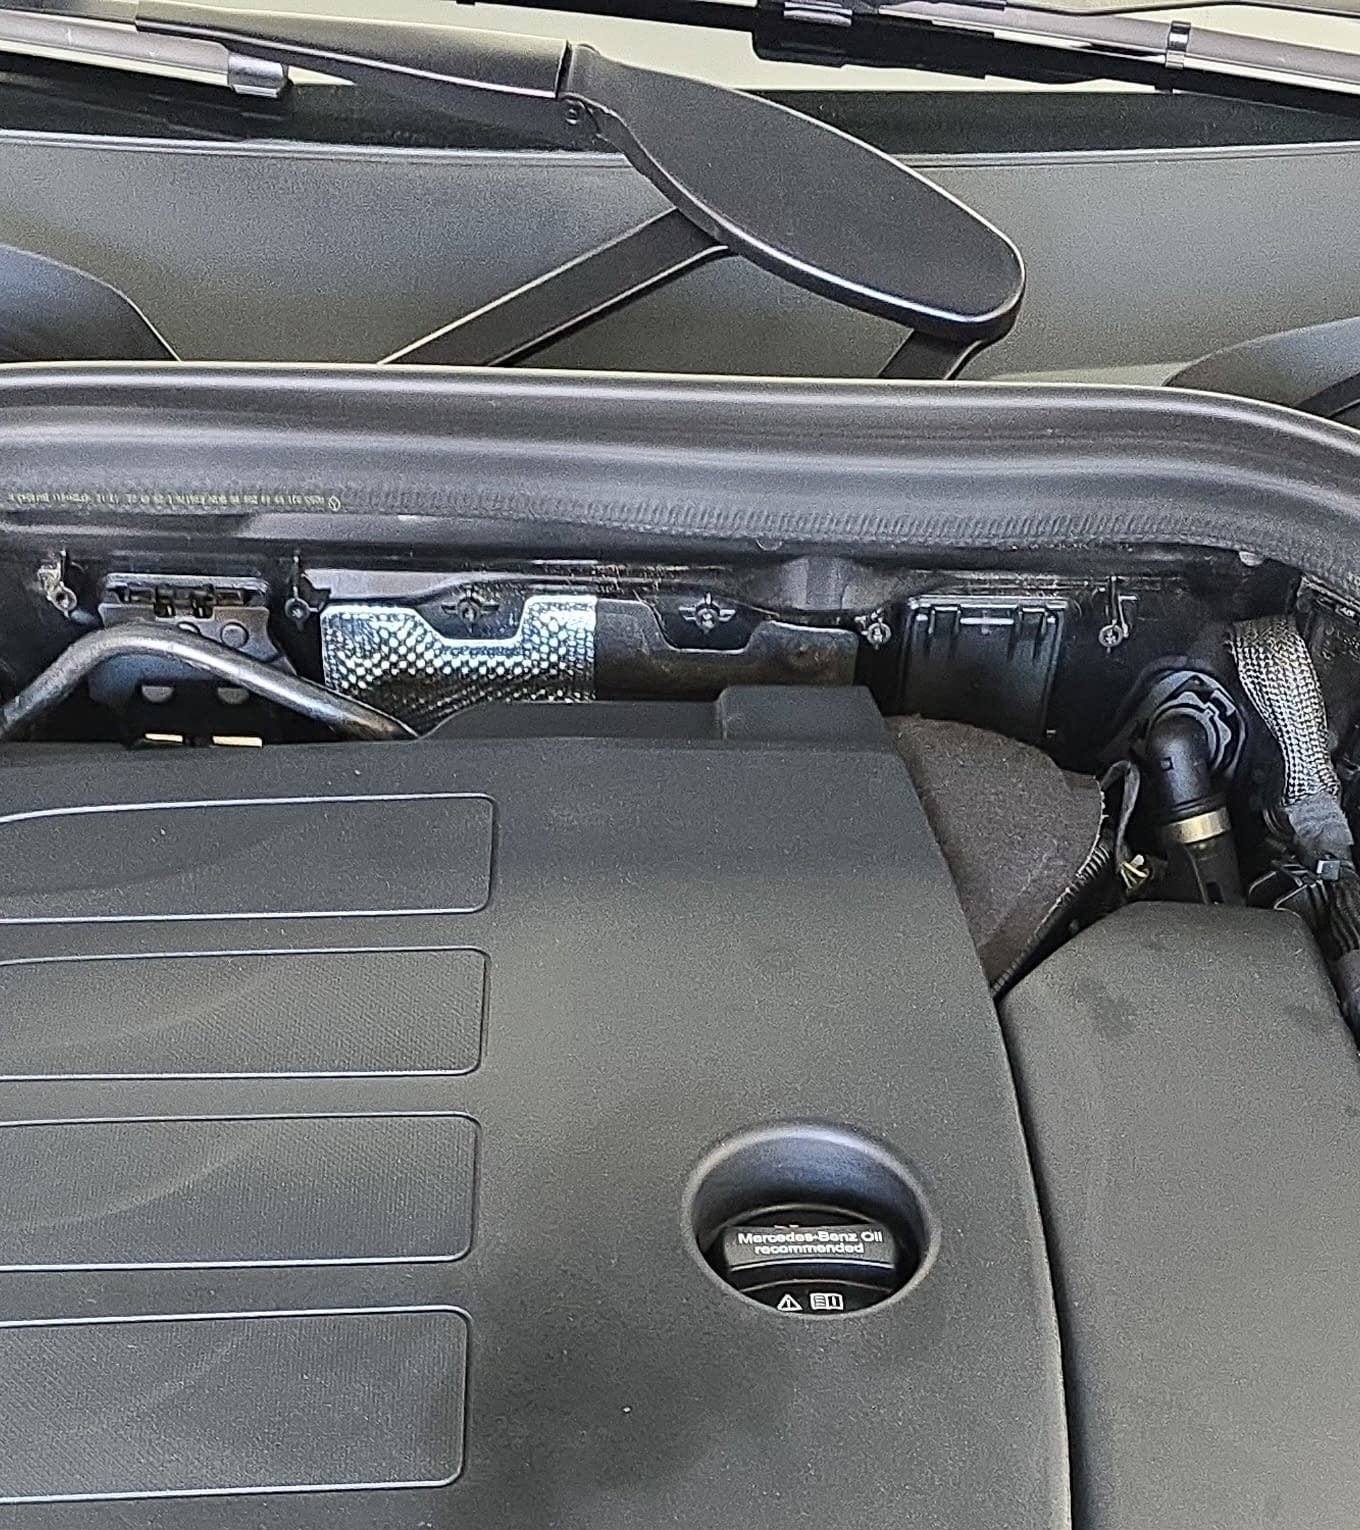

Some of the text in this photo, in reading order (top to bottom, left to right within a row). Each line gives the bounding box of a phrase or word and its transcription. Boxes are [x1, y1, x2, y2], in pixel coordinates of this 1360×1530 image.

[738, 1231, 883, 1245] Mercedes-Benz Oil
[754, 1243, 865, 1255] recommended
